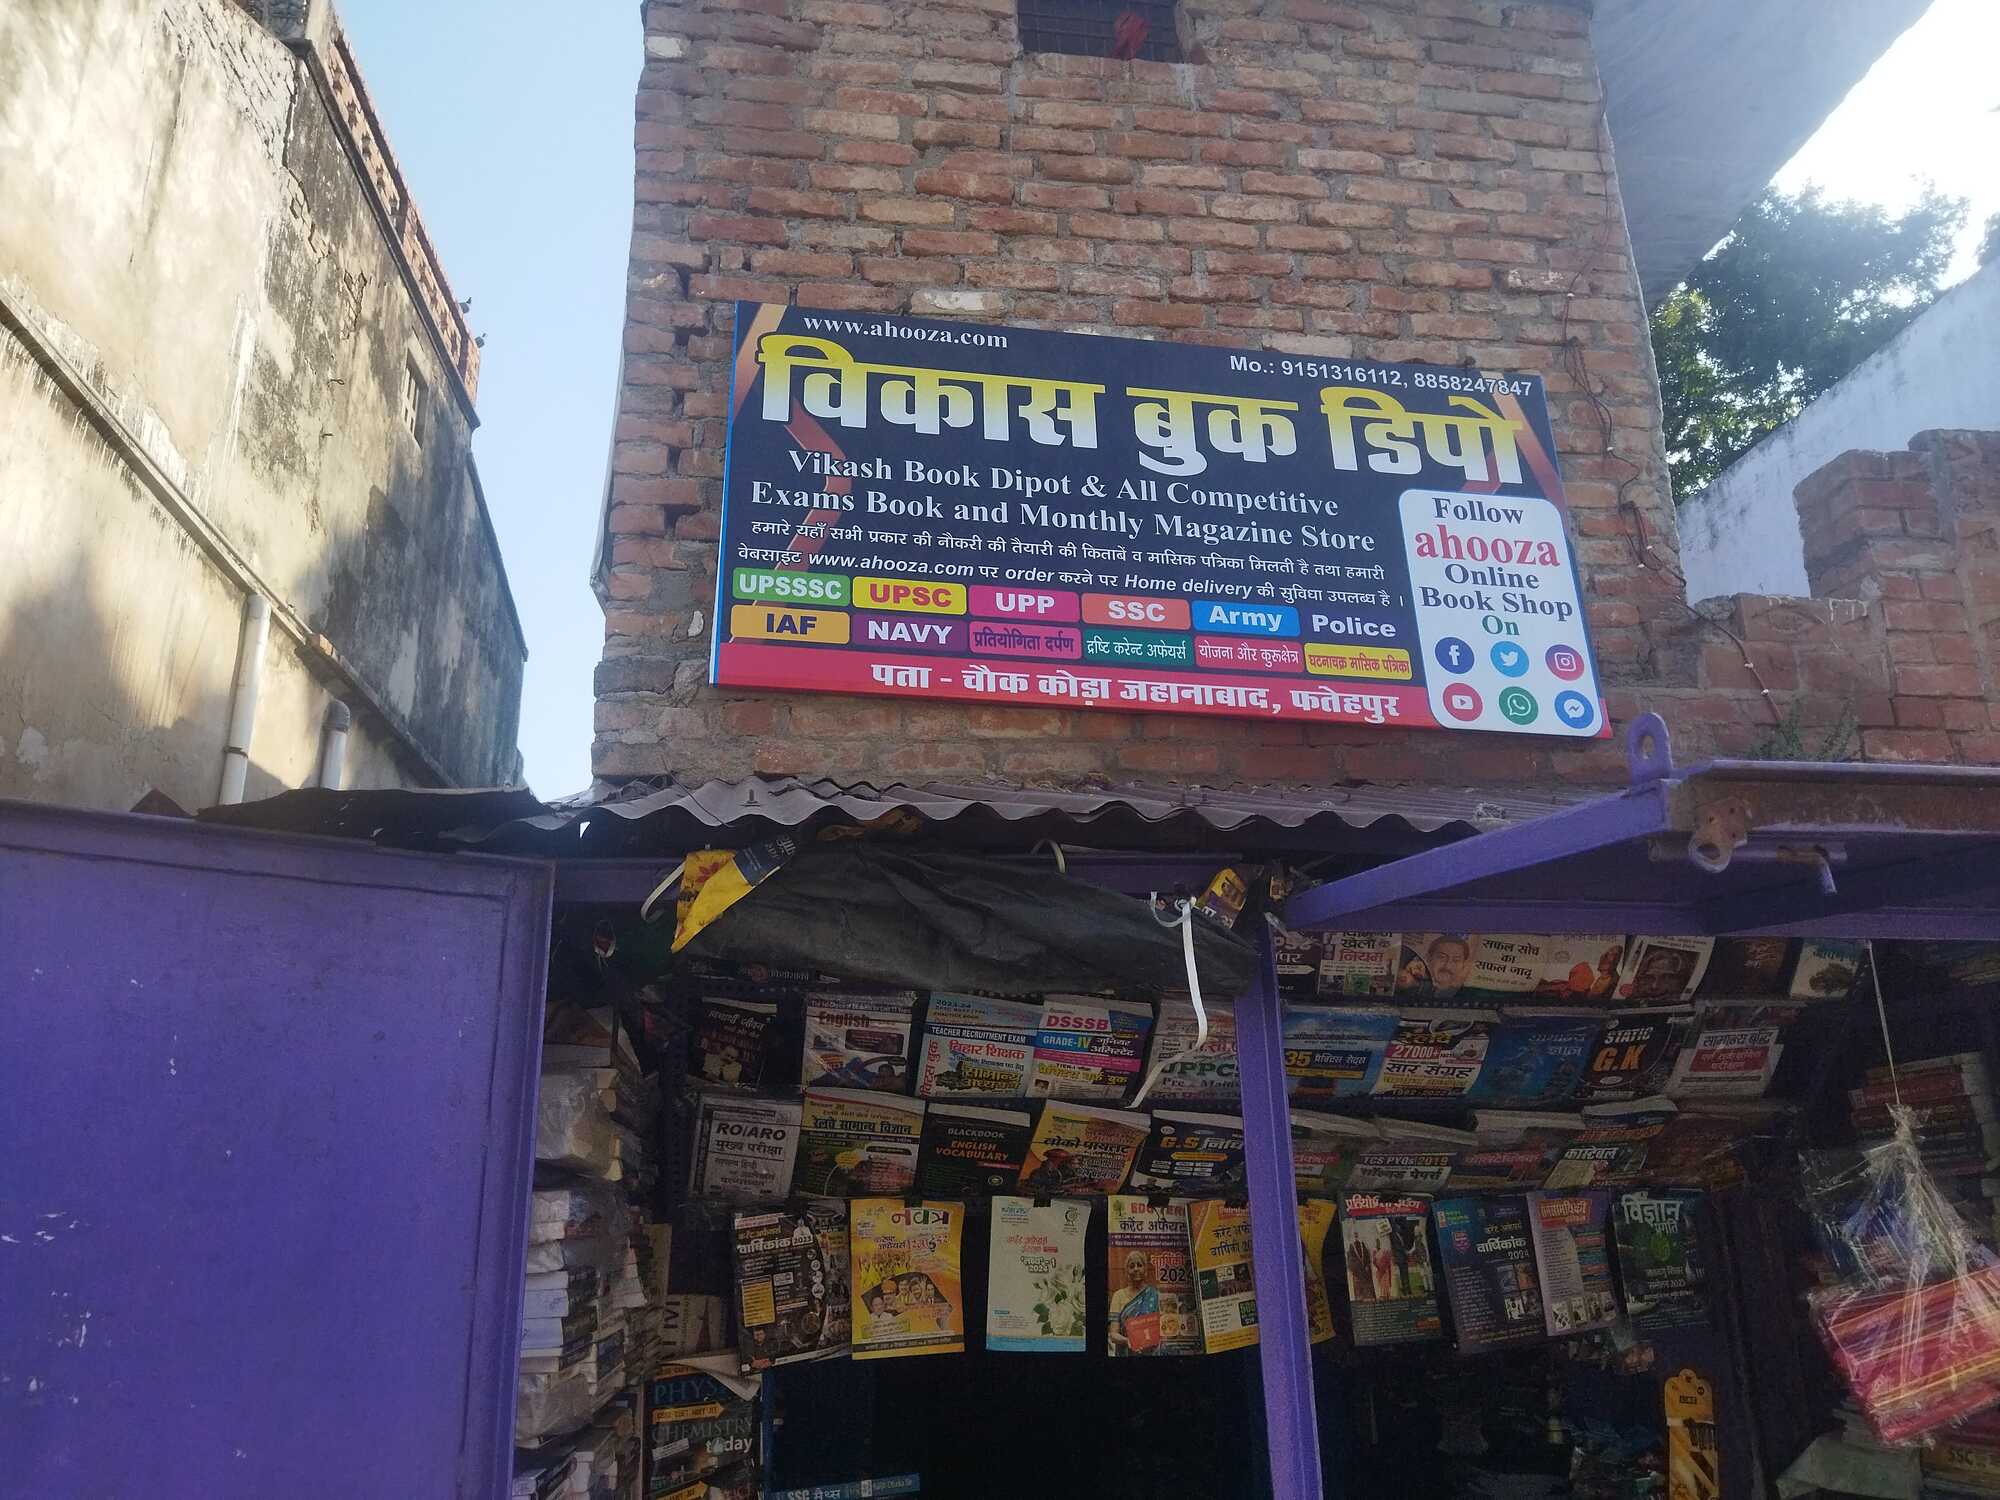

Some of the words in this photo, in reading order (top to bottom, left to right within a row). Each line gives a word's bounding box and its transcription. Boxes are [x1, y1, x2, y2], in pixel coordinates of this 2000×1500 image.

[803, 316, 1009, 349] www.ahooza.com
[1230, 355, 1275, 375] Mo.:
[1281, 359, 1409, 390] 9151316112,
[1414, 373, 1532, 397] 8858247847
[757, 334, 1106, 449] विकास
[1126, 387, 1299, 477] बुक
[1320, 387, 1524, 484] डिपो
[788, 450, 893, 481] Vikash
[903, 459, 981, 489] Book
[990, 467, 1073, 499] Dipot
[1081, 475, 1108, 498] &
[1117, 479, 1158, 502] All
[1166, 482, 1340, 517] Competitive
[751, 481, 855, 513] Exams
[866, 491, 944, 520] Book
[954, 502, 1009, 524] and
[1020, 503, 1143, 539] Monthly
[1154, 514, 1293, 545] Magazine
[1301, 524, 1376, 552] Store
[1432, 497, 1524, 525] Follow
[752, 519, 790, 536] हमारे
[796, 523, 826, 539] यहाँ
[830, 525, 863, 542] सभी
[868, 531, 907, 546] प्रकार
[913, 531, 933, 547] की
[938, 532, 983, 552] नौकरी
[988, 537, 1007, 553] की
[1011, 537, 1053, 557] तैयारी
[1058, 542, 1078, 559] की
[1082, 544, 1127, 562] किताबें
[1132, 551, 1143, 563] व
[1147, 550, 1196, 567] मासिक
[1201, 553, 1245, 570] पत्रिका
[1249, 555, 1295, 574] मिलती
[1299, 559, 1310, 576] है
[1314, 563, 1341, 577] तथा
[1346, 564, 1385, 581] हमारी
[1415, 524, 1561, 567] ahooza
[738, 543, 802, 565] वेबसाइट
[808, 552, 974, 577] www.ahooza.com
[978, 565, 999, 579] पर
[1005, 566, 1055, 584] order
[1060, 569, 1093, 586] करने
[1099, 573, 1119, 588] पर
[1125, 574, 1177, 592] Home
[1182, 577, 1253, 600] delivery
[1256, 581, 1275, 598] की
[1280, 584, 1323, 604] सुविधा
[1327, 590, 1376, 606] उपलब्ध
[1381, 589, 1392, 607] है
[1445, 563, 1540, 590] Online
[739, 573, 843, 600] UPSSSC
[869, 583, 953, 608] UPSC
[995, 592, 1056, 614] UPP
[1107, 599, 1167, 623] SSC
[1418, 586, 1495, 612] Book
[1502, 593, 1573, 622] Shop
[766, 612, 818, 637] IAF
[1208, 605, 1283, 633] Army
[1311, 614, 1397, 639] Police
[1482, 615, 1520, 636] On
[867, 619, 953, 645] NAVY
[973, 629, 1041, 651] प्रतियोगिता
[1044, 632, 1074, 654] दर्पण
[1114, 637, 1144, 658] करेन्ट
[1147, 640, 1188, 661] अफेयर्स
[1199, 643, 1233, 661] योजना
[1237, 643, 1257, 661] और
[1308, 654, 1347, 671] घटनाचक्र
[1350, 654, 1381, 672] मासिक
[1383, 655, 1411, 674] पत्रिका
[870, 664, 933, 689] पता
[962, 665, 1030, 695] चौक
[1038, 669, 1112, 706] कोड़ा
[1117, 678, 1283, 715] जहानाबाद,
[1289, 686, 1401, 725] फतेहपुर
[1482, 938, 1514, 951] सफल
[1517, 942, 1540, 957] सोच
[1474, 960, 1507, 974] सफल
[1500, 954, 1516, 964] का
[819, 1011, 870, 1028] English
[1046, 1015, 1109, 1031] DSSSB
[931, 1026, 961, 1037] TEACHER
[962, 1029, 1007, 1042] RECRUITMENT
[1007, 1033, 1027, 1044] EXAM
[1043, 1035, 1092, 1049] GRADE-IV
[1604, 1026, 1654, 1045] STATIC
[949, 1039, 984, 1056] बिहार
[986, 1043, 1027, 1060] शिक्षक
[1284, 1051, 1313, 1067] 35
[1393, 1044, 1440, 1060] 27000+
[1385, 1062, 1420, 1075] सार
[716, 1122, 787, 1141] RO/ARO
[947, 1128, 1006, 1140] BLACKBOOK
[714, 1140, 745, 1152] मुख्य
[747, 1142, 784, 1156] परीक्षा
[935, 1147, 1010, 1161] VOCABULARY
[951, 1140, 997, 1151] ENGLISH
[1363, 1156, 1385, 1166] TCS
[1416, 1156, 1449, 1167] 2019
[1622, 1191, 1684, 1225] विज्ञान
[1119, 1217, 1145, 1232] करेंट
[1476, 1236, 1528, 1254] वार्षिकांक
[652, 1417, 753, 1442] CHEMISTRY
[705, 1436, 753, 1455] today
